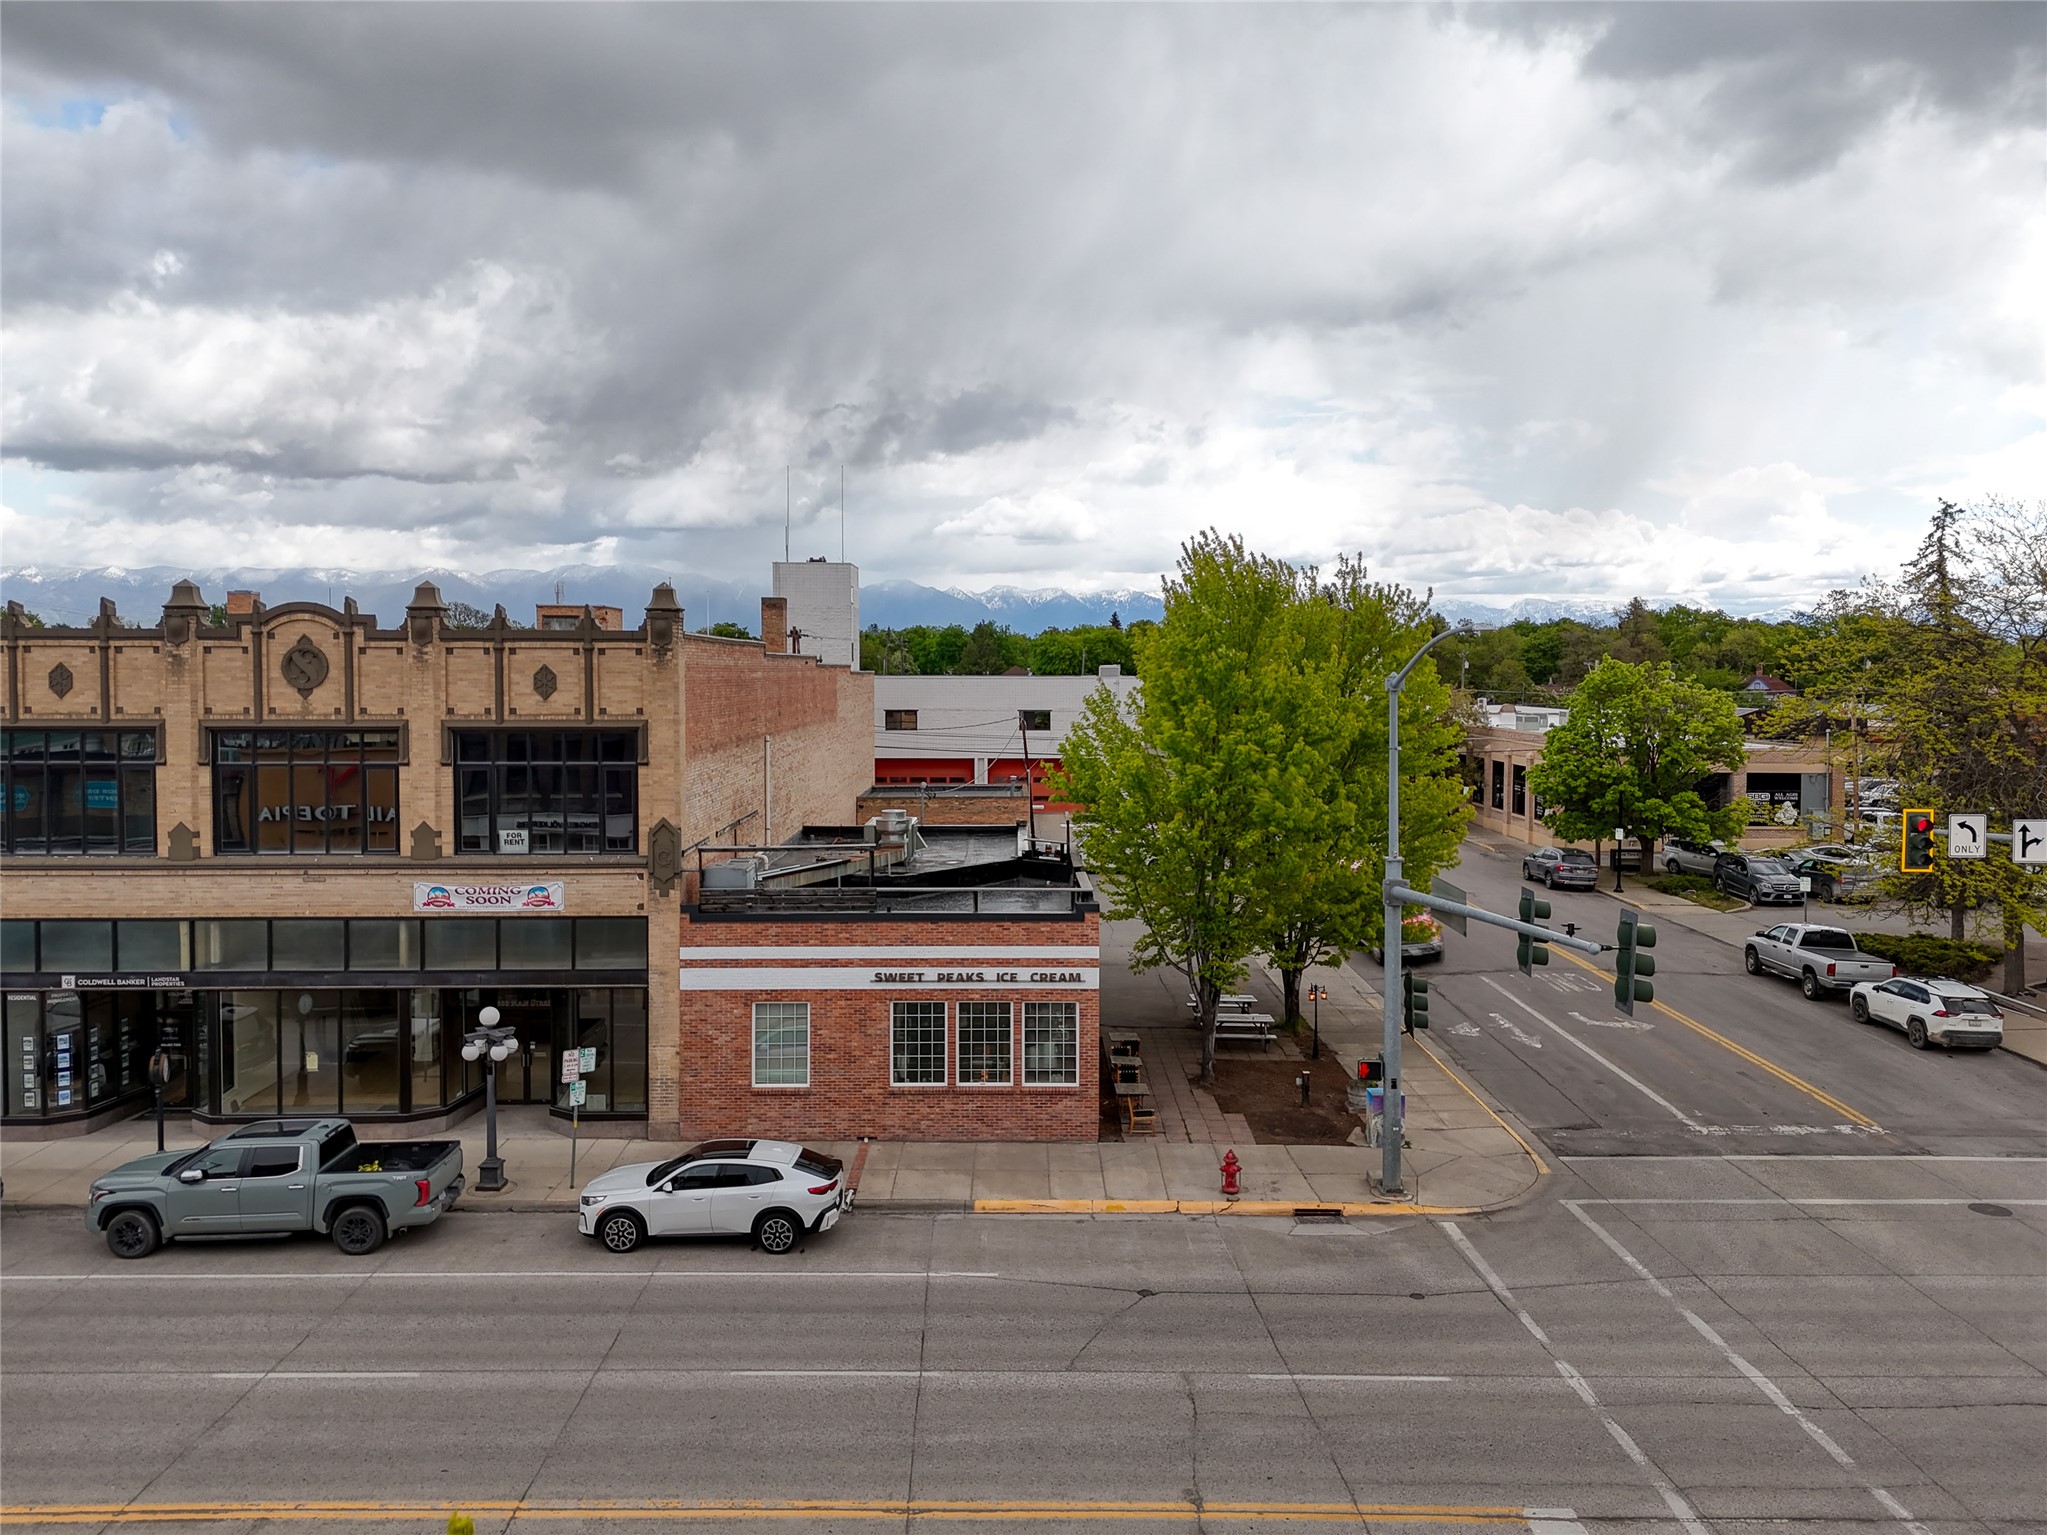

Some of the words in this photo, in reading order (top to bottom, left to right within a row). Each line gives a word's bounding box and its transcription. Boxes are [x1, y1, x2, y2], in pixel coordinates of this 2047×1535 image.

[1954, 845, 1981, 854] ONLY
[454, 886, 522, 895] COMING
[465, 896, 512, 905] SOON
[874, 972, 925, 983] SWEET
[937, 972, 984, 983] PEAKS
[996, 972, 1018, 983] ICE
[1030, 972, 1081, 983] CREAM
